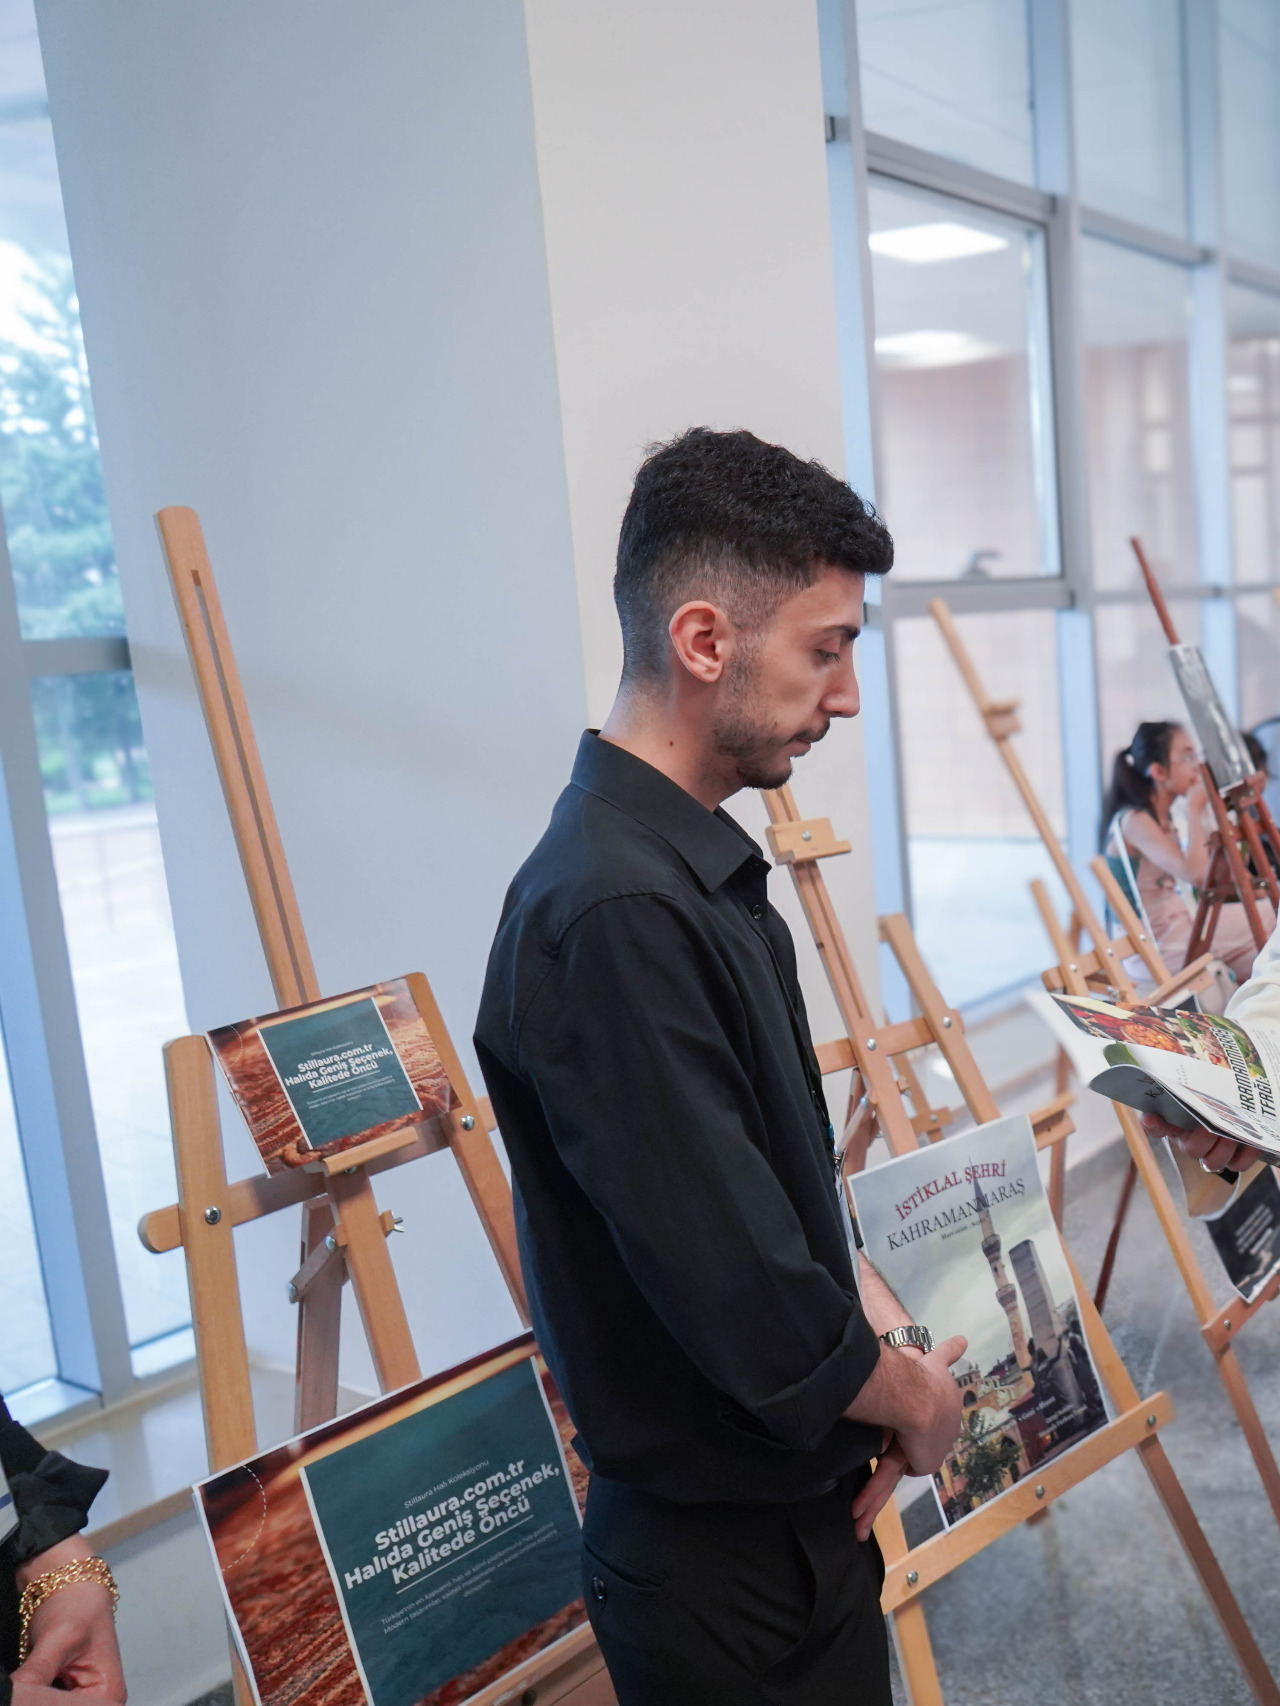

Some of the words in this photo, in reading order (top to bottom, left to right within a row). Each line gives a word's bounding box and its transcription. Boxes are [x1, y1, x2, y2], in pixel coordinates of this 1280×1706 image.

[284, 1071, 319, 1087] Halıda
[319, 1060, 348, 1075] Geniş
[297, 1043, 373, 1073] Stillaura.com.tr
[308, 1069, 350, 1089] Kalitede
[351, 1060, 379, 1075] Öncü
[1209, 1026, 1257, 1114] HRAMANMARAŞ
[886, 1177, 1025, 1251] KAHRAMANMARAŞ
[895, 1169, 962, 1222] İSTİKLAL
[964, 1159, 1007, 1185] ŞEHRİ
[344, 1543, 414, 1590] Halıda
[417, 1509, 473, 1548] Geniş
[475, 1463, 560, 1510] Seçenek,
[375, 1460, 524, 1551] Stillaura.com.tr
[391, 1529, 476, 1585] Kalitede
[479, 1494, 531, 1533] Öncü
